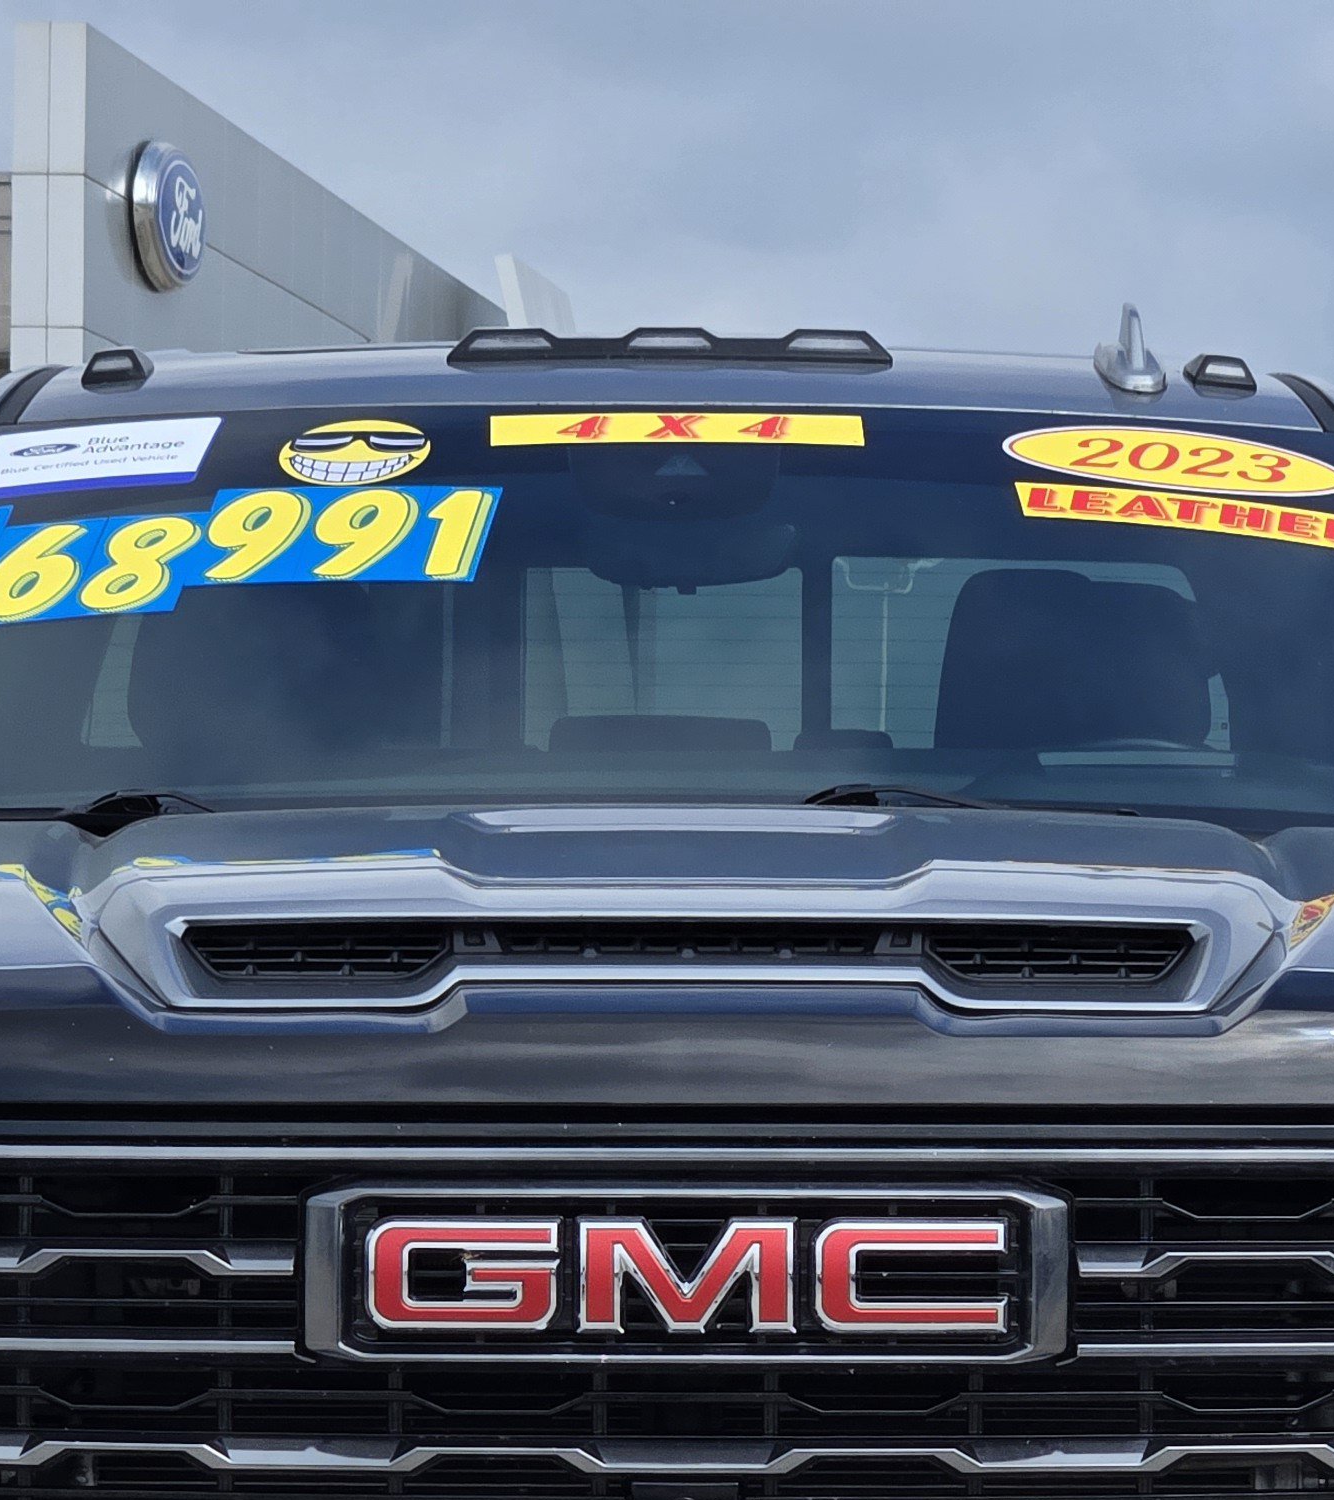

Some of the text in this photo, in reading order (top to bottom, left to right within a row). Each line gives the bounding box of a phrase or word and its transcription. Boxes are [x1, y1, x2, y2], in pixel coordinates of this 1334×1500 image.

[170, 175, 203, 260] Ford
[556, 414, 789, 439] 4 X 4
[81, 439, 186, 455] Advantage
[88, 435, 130, 446] Blue
[0, 453, 179, 475] Blue Certified Used Vehicle
[1068, 437, 1292, 484] 2023
[364, 1216, 1010, 1334] GMC
